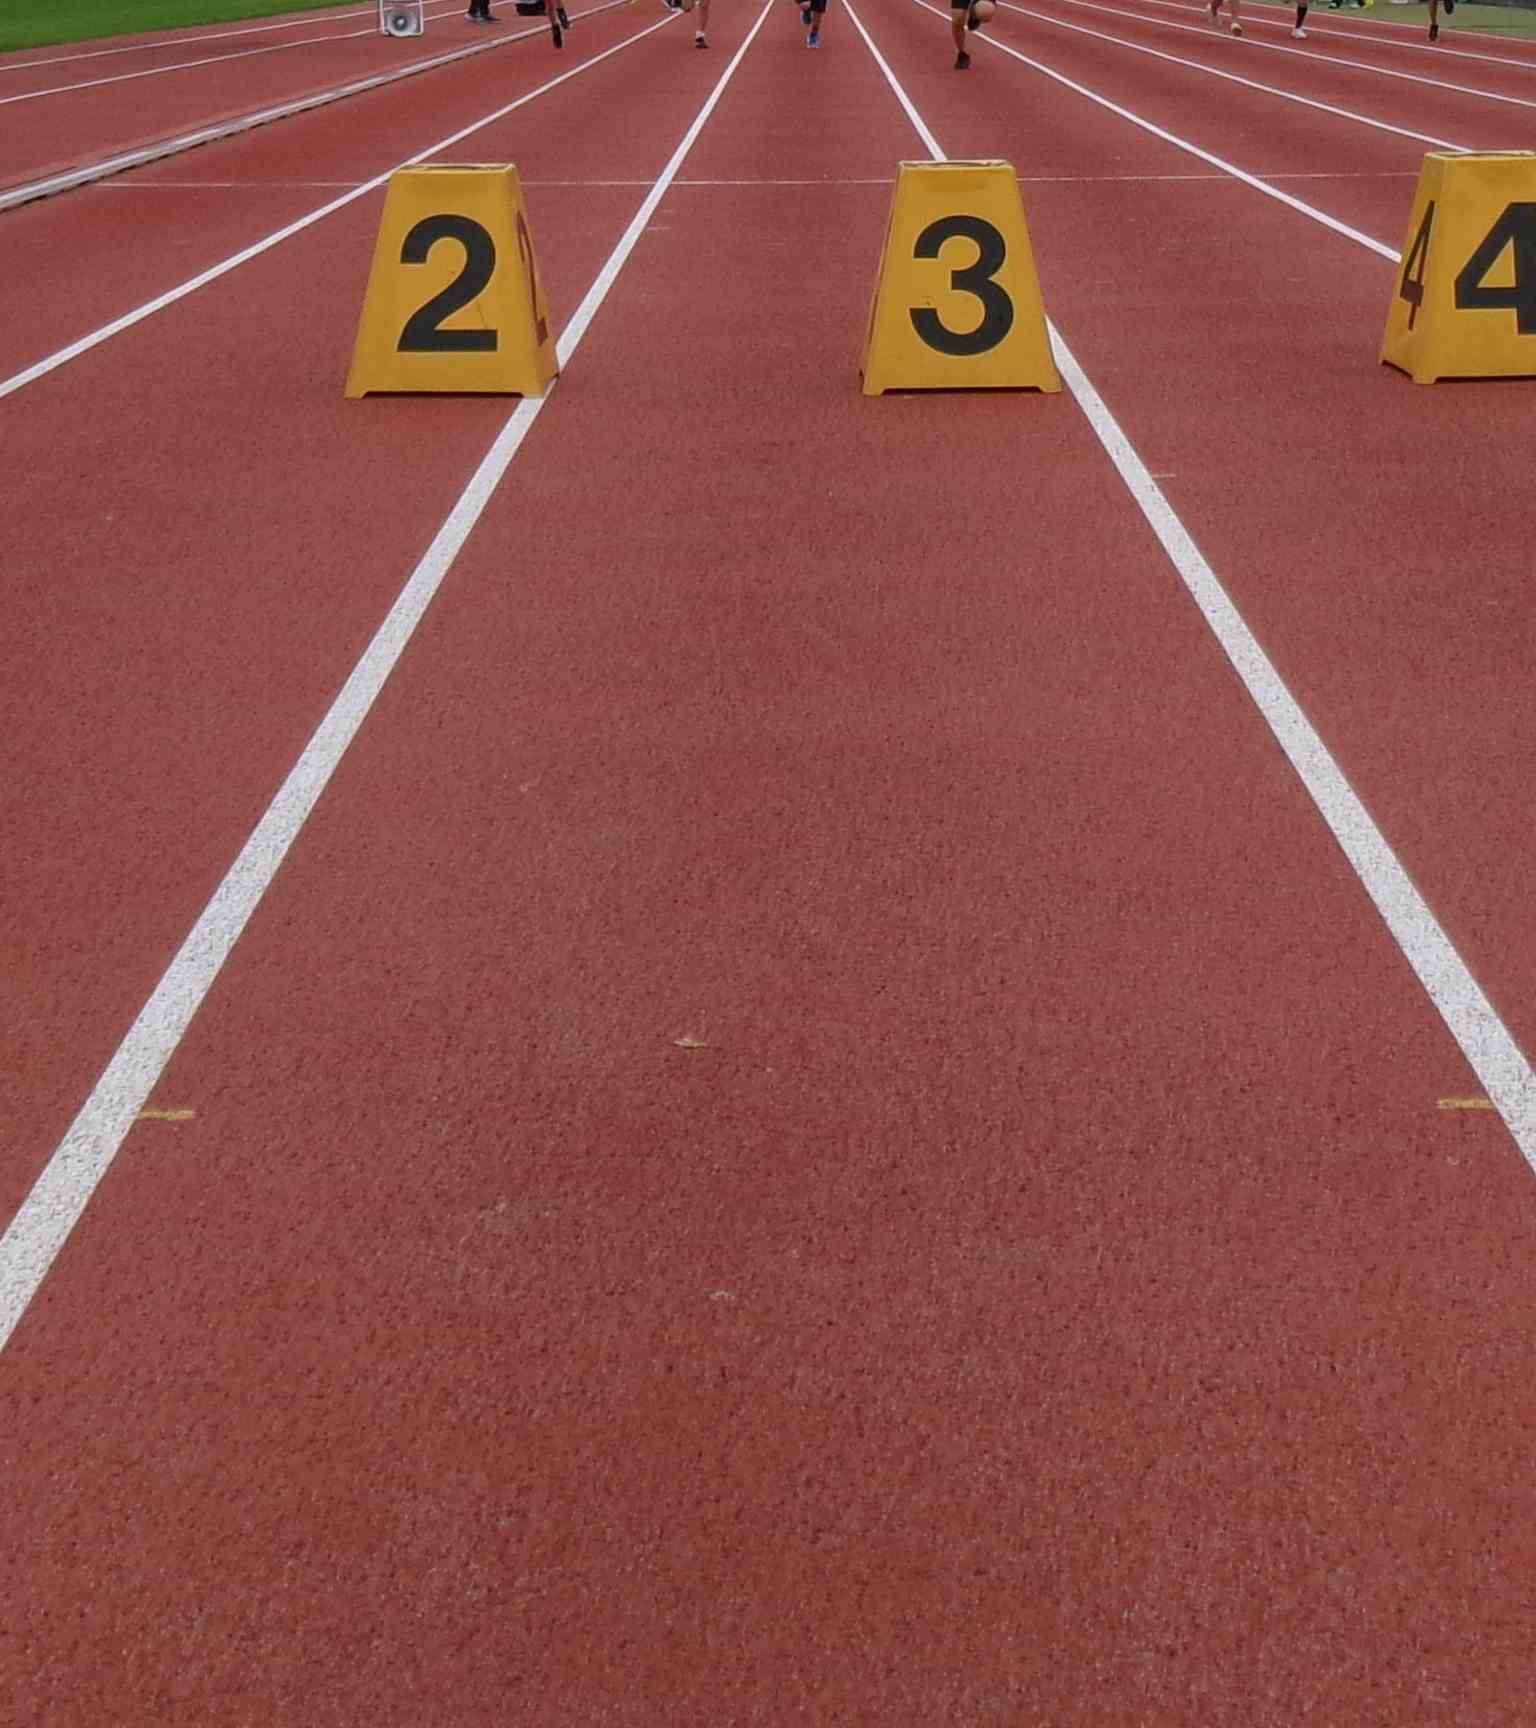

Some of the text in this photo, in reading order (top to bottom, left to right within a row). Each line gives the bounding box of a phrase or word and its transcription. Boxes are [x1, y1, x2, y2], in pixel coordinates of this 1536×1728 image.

[397, 213, 499, 352] 2
[909, 215, 1015, 357] 3
[1399, 200, 1436, 332] 4
